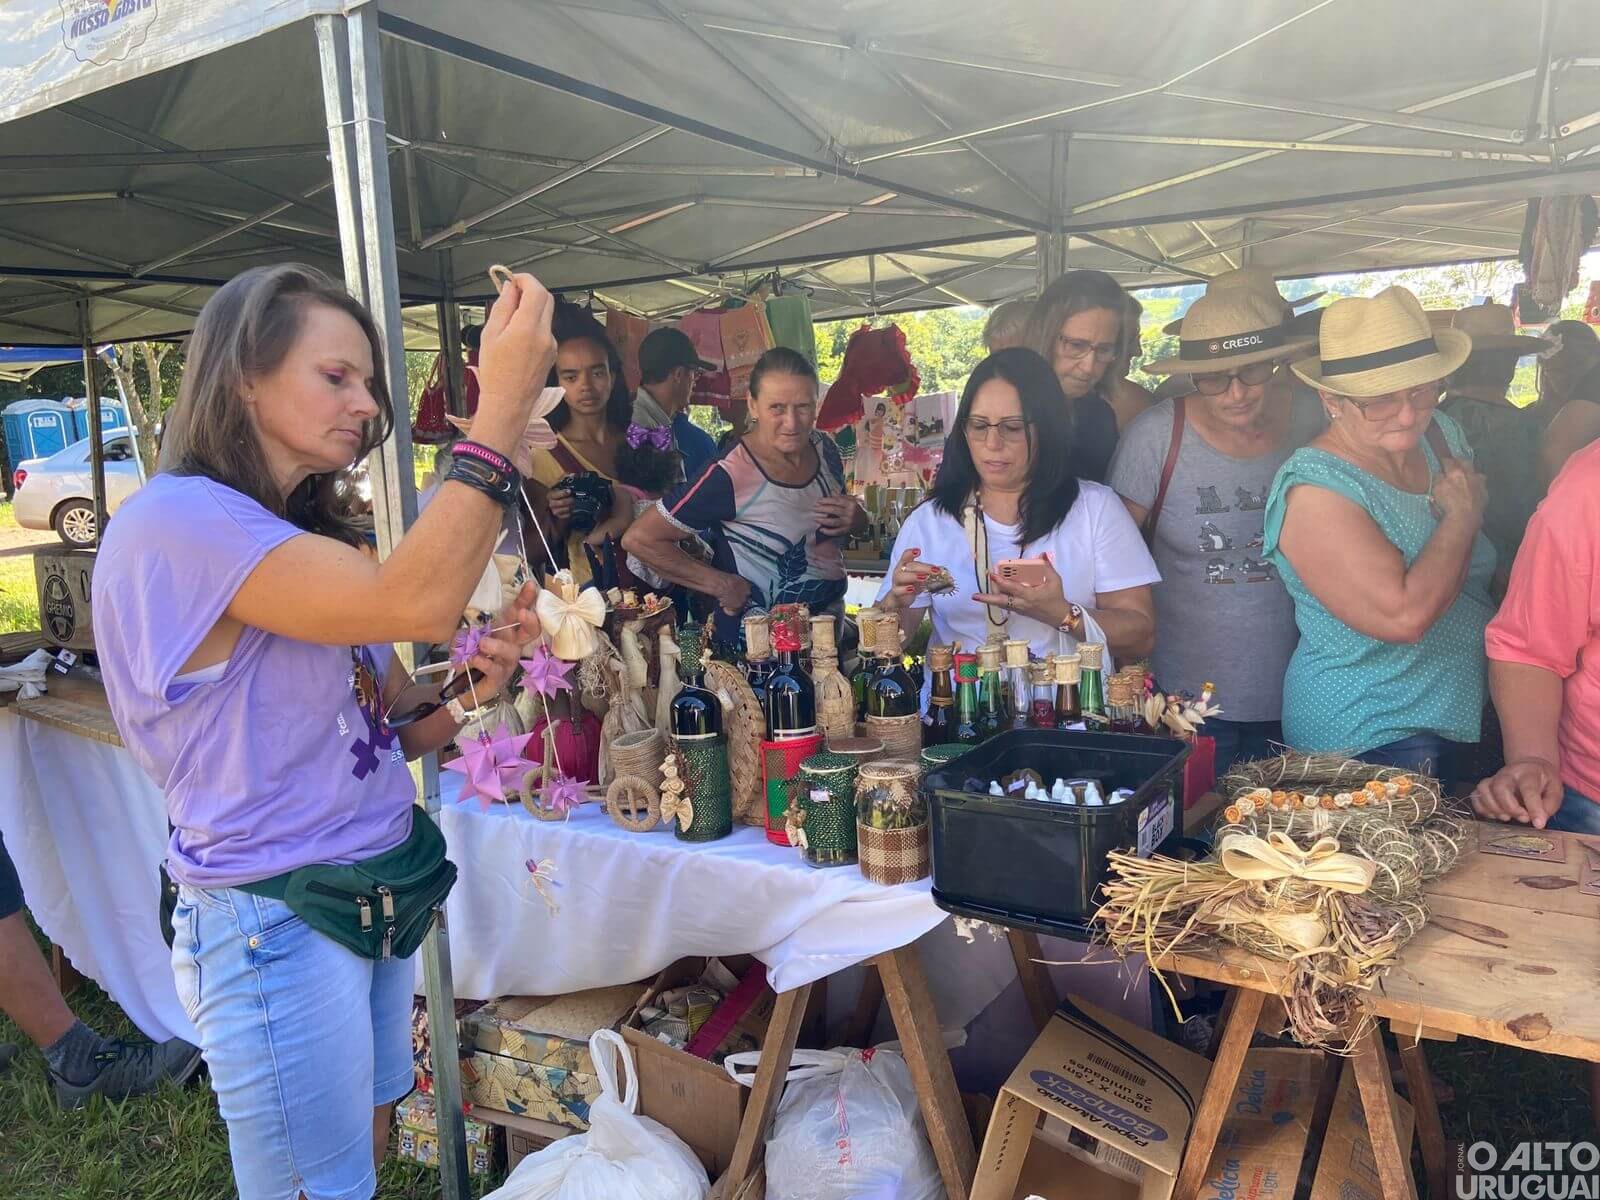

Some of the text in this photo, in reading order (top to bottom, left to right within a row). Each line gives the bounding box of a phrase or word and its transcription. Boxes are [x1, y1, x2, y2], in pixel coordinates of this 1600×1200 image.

[1222, 335, 1264, 350] CRESOL
[1069, 1059, 1153, 1105] 25 unidades
[1043, 1076, 1154, 1136] Bompack
[1114, 1091, 1152, 1113] 30cm
[1102, 1122, 1149, 1147] Papel
[1206, 1159, 1240, 1200] elicia
